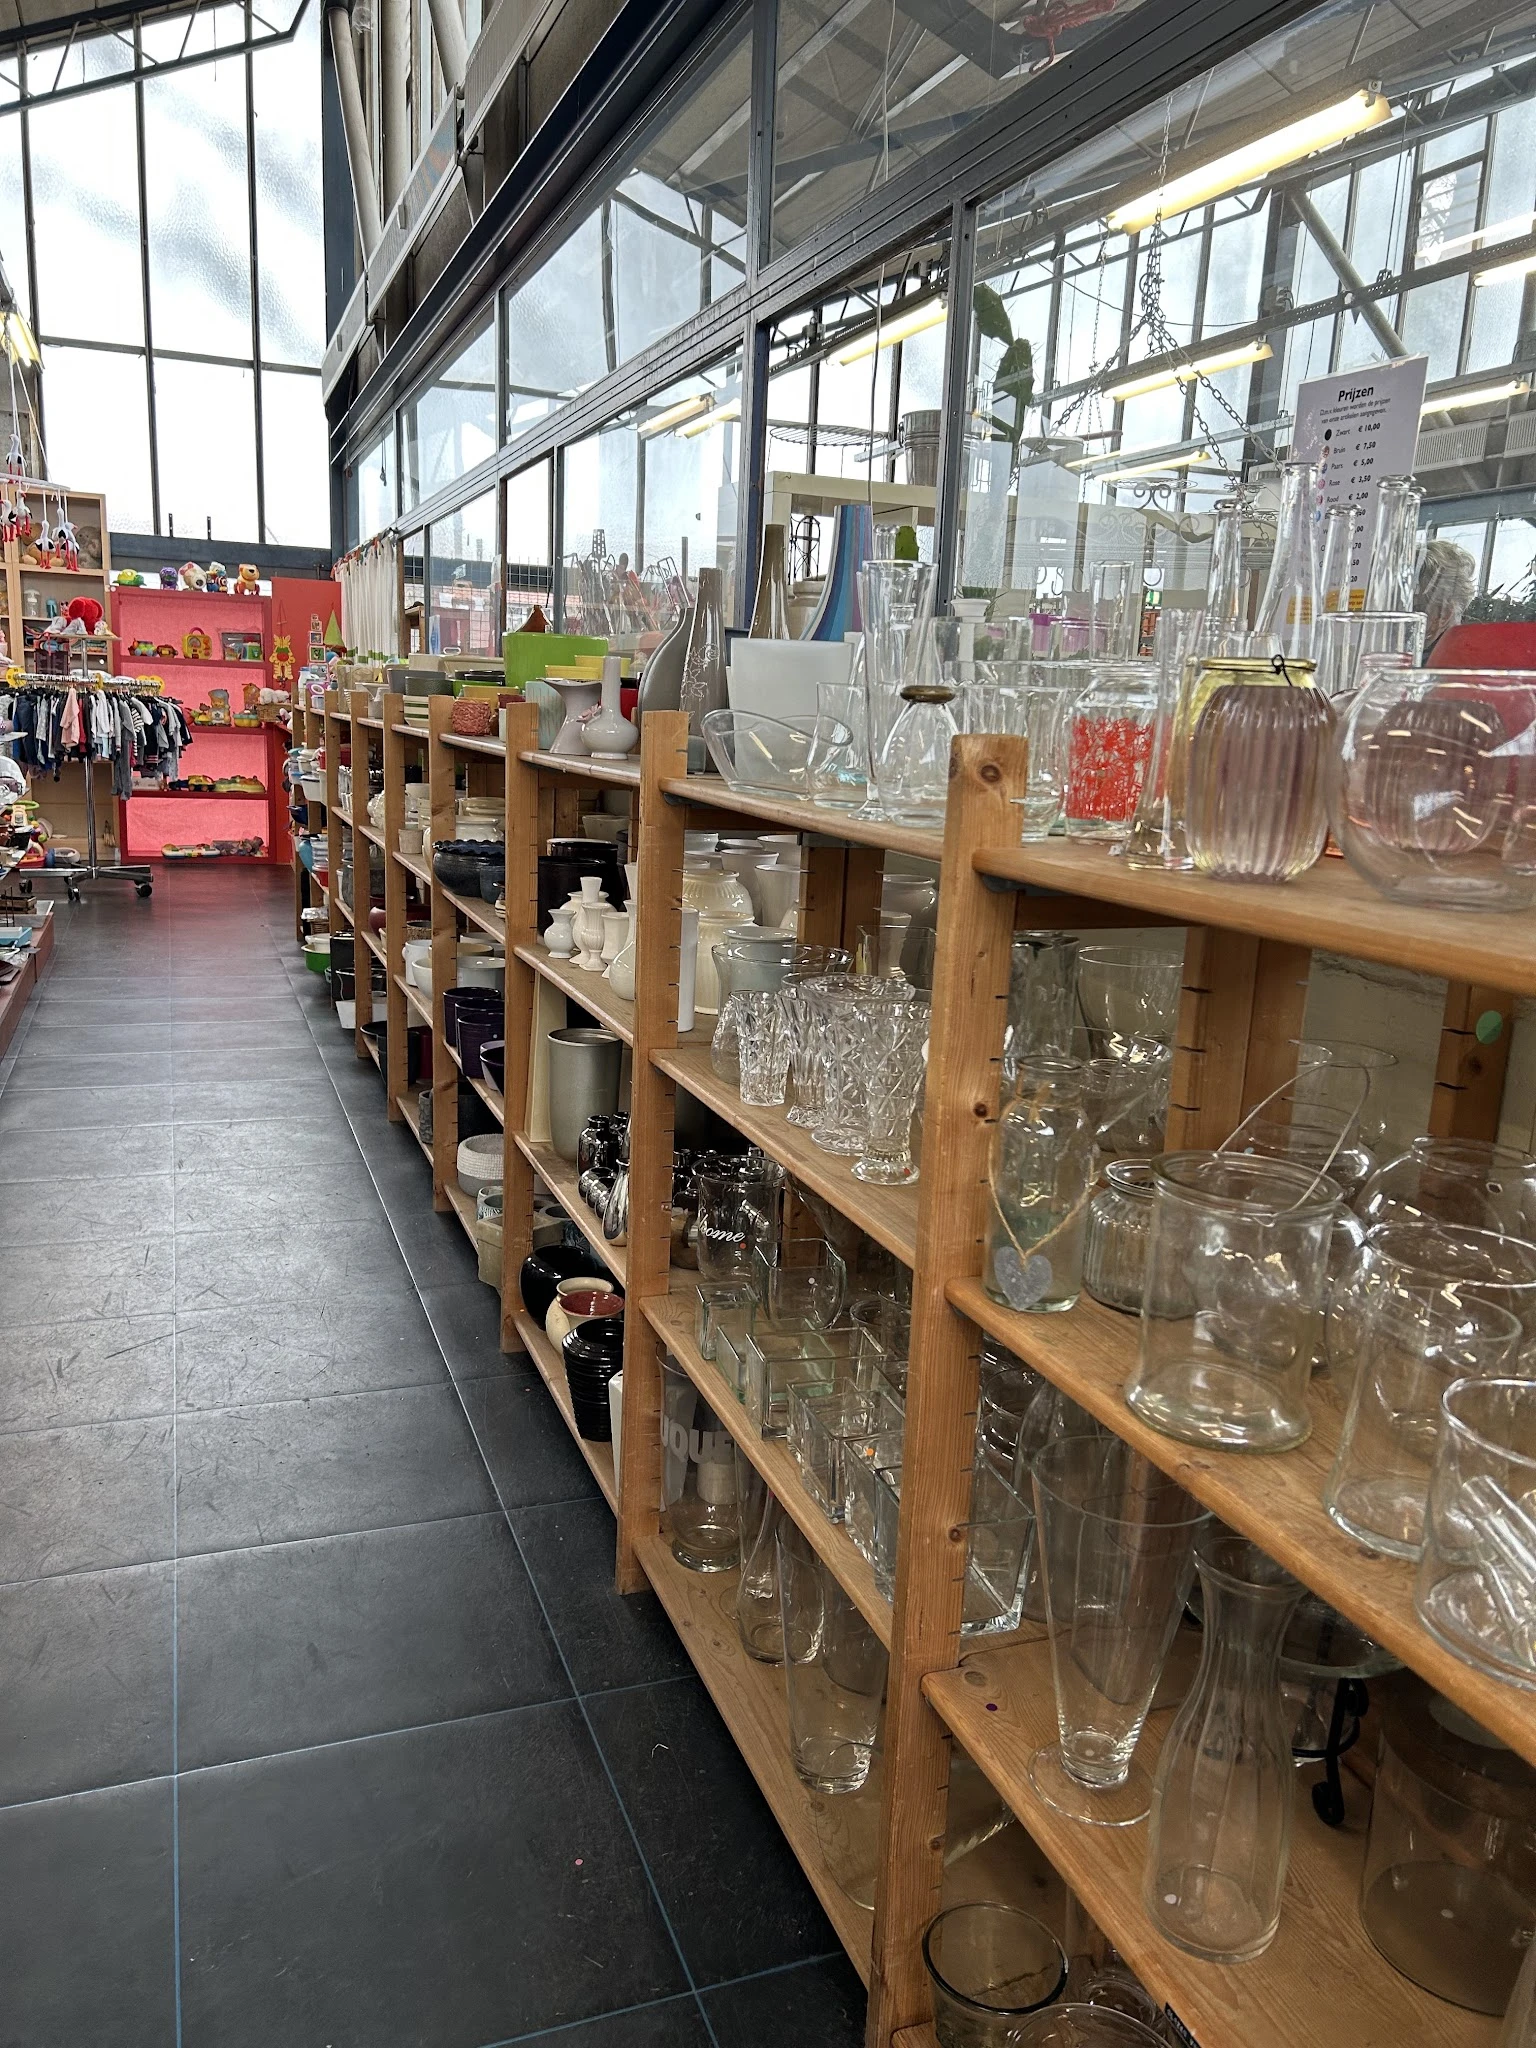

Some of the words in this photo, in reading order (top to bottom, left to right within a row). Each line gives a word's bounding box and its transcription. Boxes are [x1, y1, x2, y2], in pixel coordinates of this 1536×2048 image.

[1338, 386, 1374, 402] Prijzen
[1373, 398, 1391, 407] prijzen
[1336, 429, 1351, 437] Zwart
[1358, 425, 1363, 433] €
[1364, 422, 1381, 432] 10,00
[1355, 443, 1361, 451] €
[1363, 441, 1377, 450] 7,50
[1331, 462, 1344, 470] Paars
[1353, 459, 1359, 467] €
[1360, 457, 1374, 466] 5,00
[1350, 476, 1356, 484] €
[1358, 474, 1372, 483] 3,50
[1326, 495, 1340, 503] Rood
[1348, 493, 1353, 501] €
[1355, 491, 1369, 500] 2,00
[698, 1207, 745, 1243] home
[660, 1413, 734, 1465] UQUE
